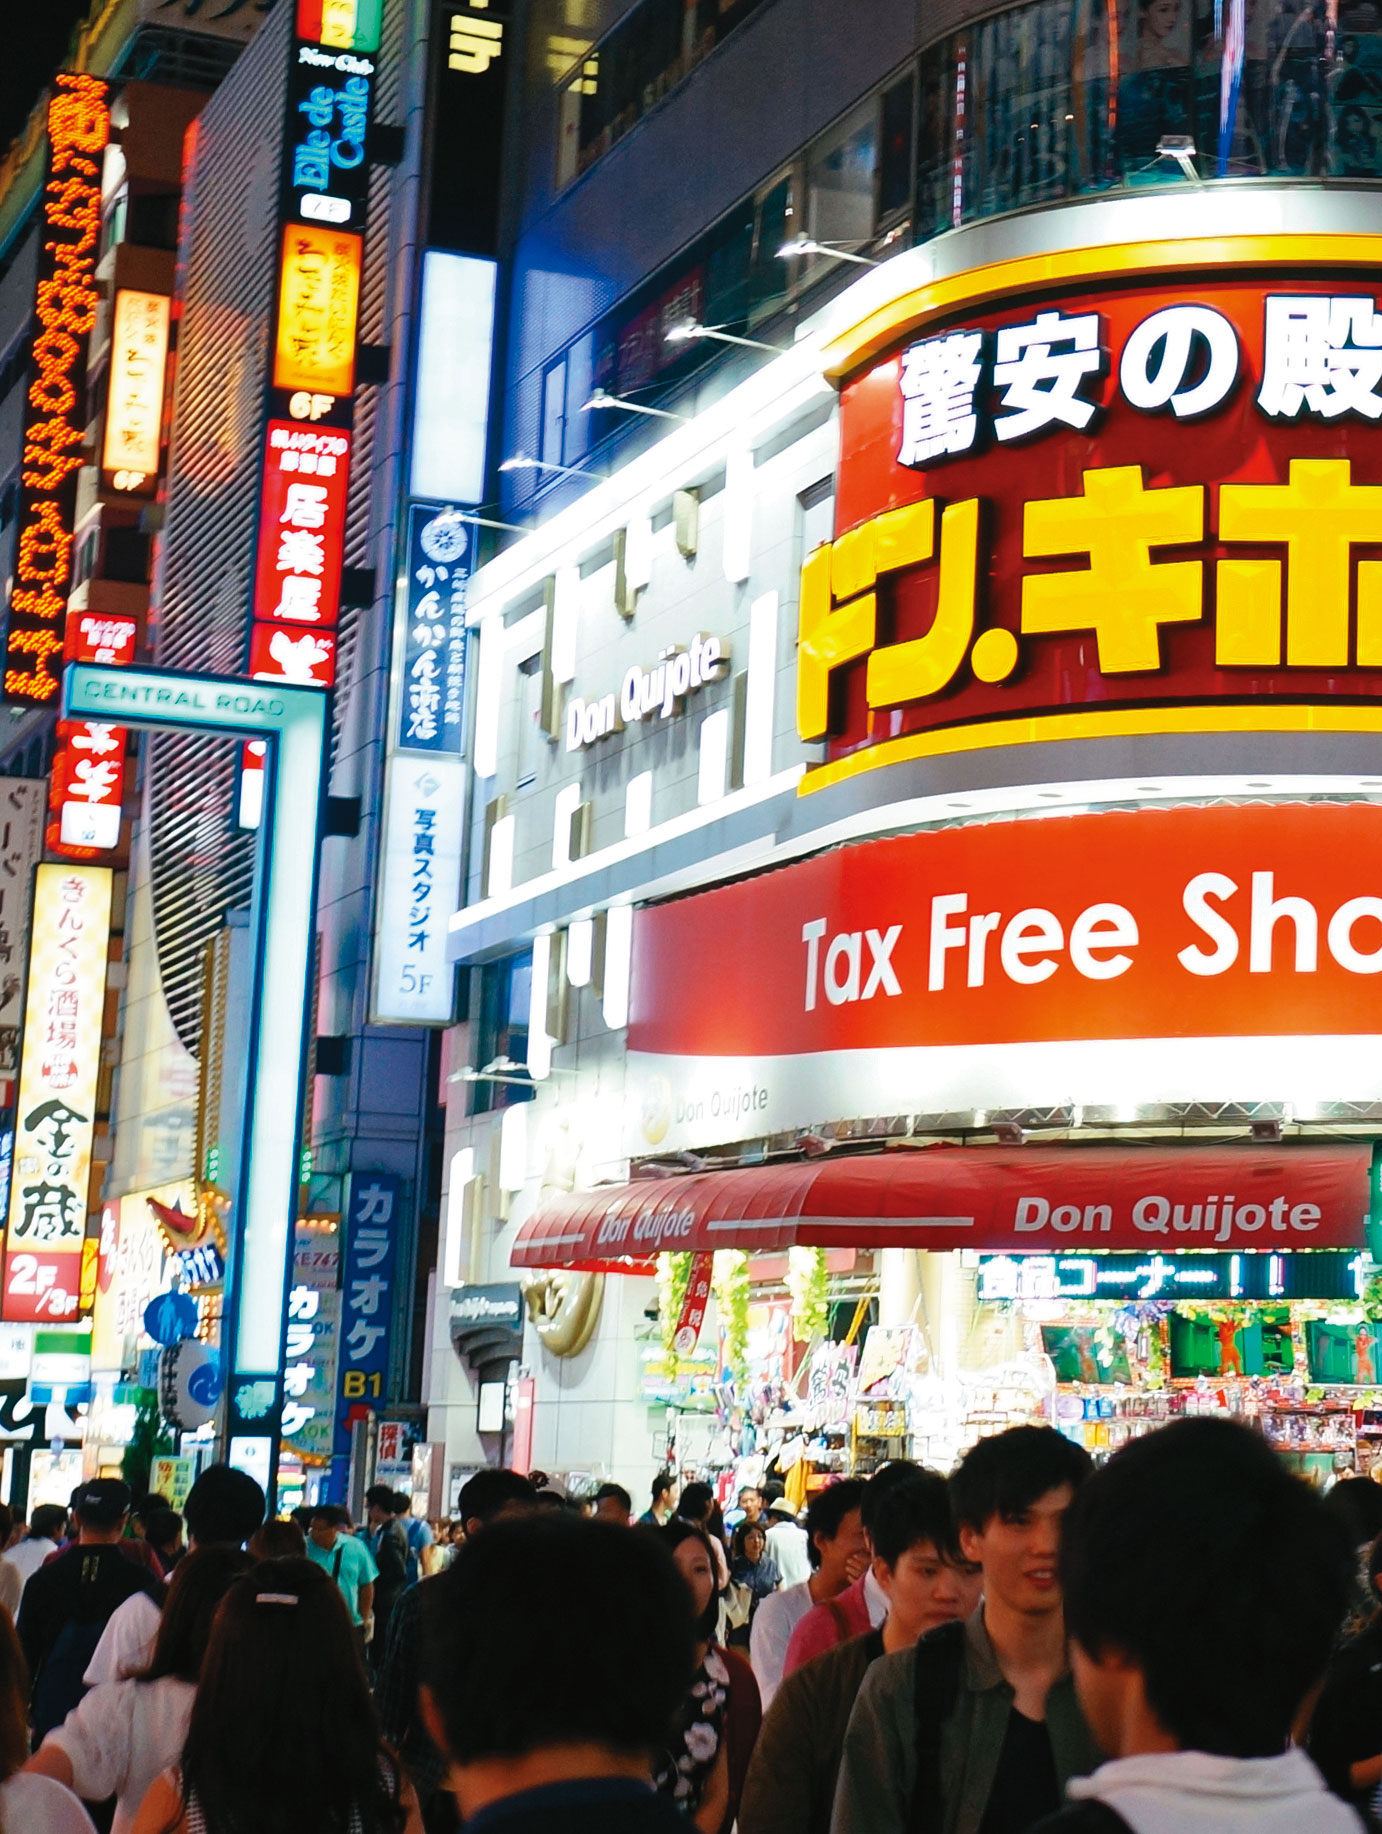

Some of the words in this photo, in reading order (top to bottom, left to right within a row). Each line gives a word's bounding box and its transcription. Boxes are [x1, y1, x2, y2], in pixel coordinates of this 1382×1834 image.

[289, 391, 335, 421] 6F
[84, 680, 206, 709] CENTRAL
[216, 694, 285, 716] ROAD
[566, 693, 614, 753] Don
[620, 631, 721, 721] Quijote
[407, 808, 437, 952] 写真スタジオ
[48, 877, 86, 1049] きんくら酒場
[399, 964, 434, 994] 5F
[802, 918, 903, 1012] Tax
[929, 893, 1140, 992] Free
[676, 1096, 704, 1124] Don
[711, 1085, 768, 1121] Quijote
[14, 1098, 90, 1241] 金の蔵
[597, 1214, 631, 1245] Don
[633, 1204, 695, 1248] Quijote
[1013, 1197, 1112, 1232] Don
[1132, 1195, 1321, 1242] Quijote
[346, 1183, 393, 1361] カラオケ
[281, 1285, 320, 1437] カラオケ
[343, 1370, 381, 1398] B1
